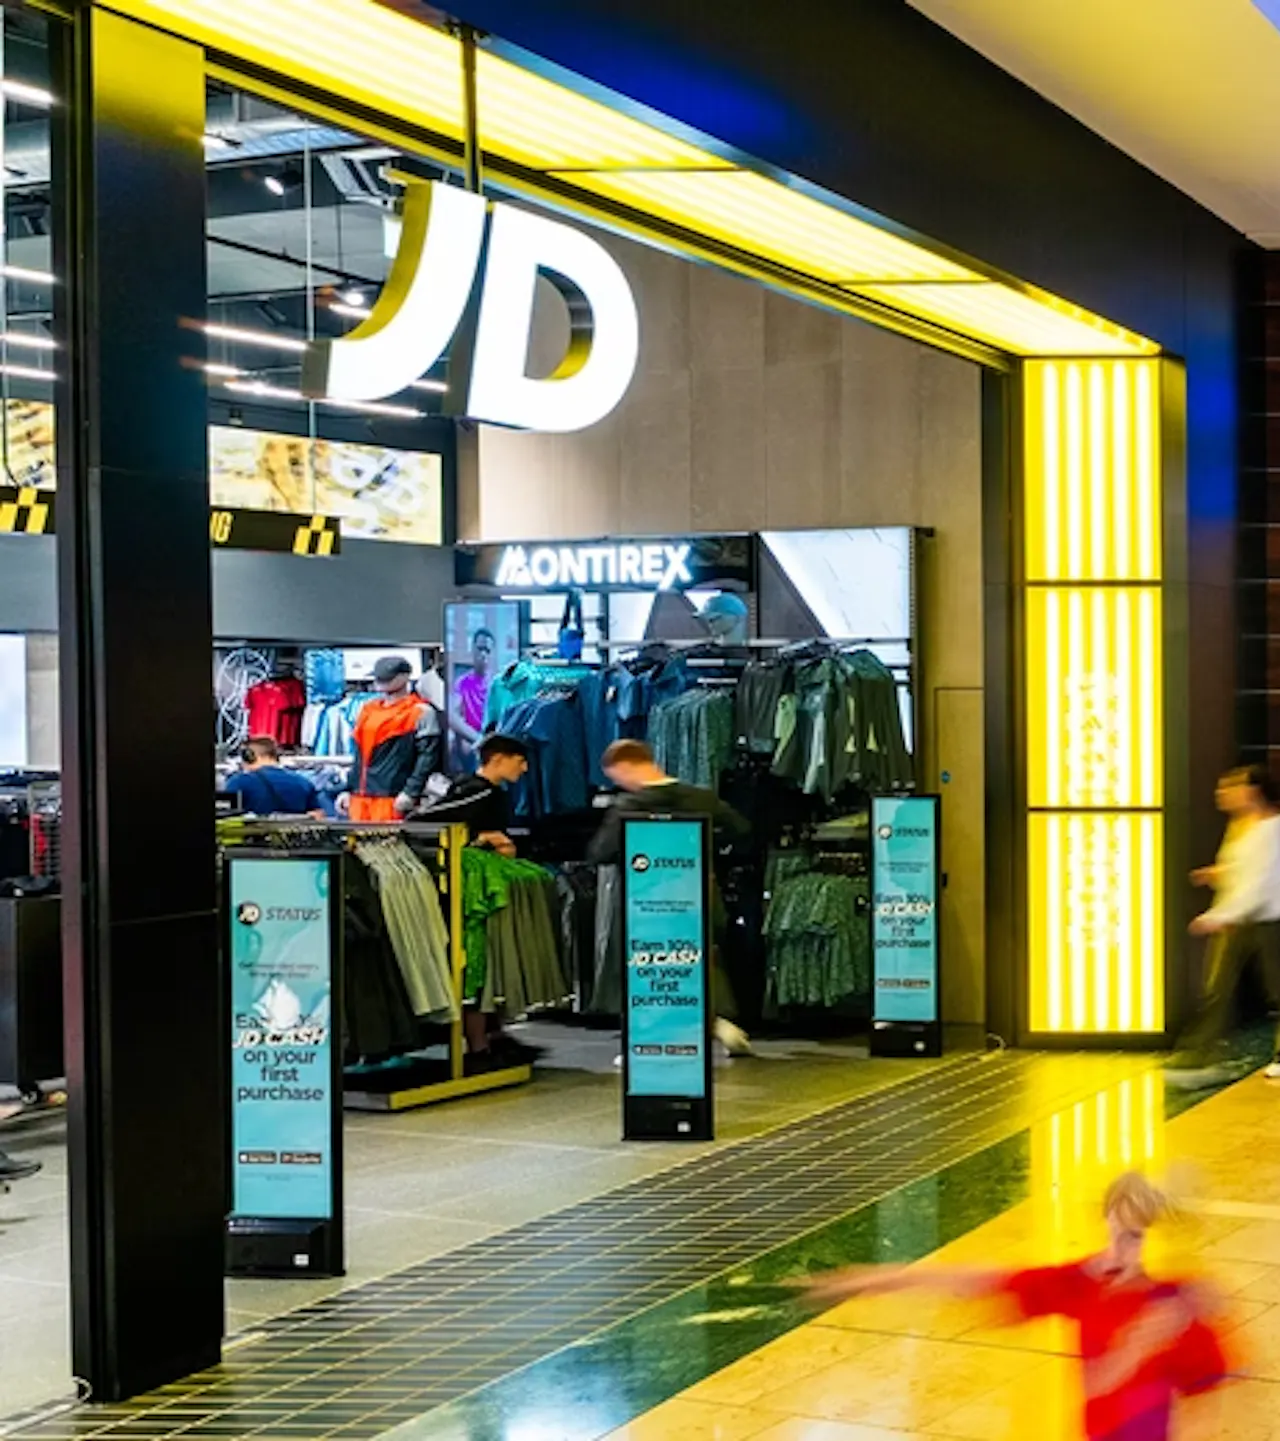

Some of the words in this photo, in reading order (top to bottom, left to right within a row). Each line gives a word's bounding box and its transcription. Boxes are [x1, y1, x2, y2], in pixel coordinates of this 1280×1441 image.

[308, 178, 639, 432] JD
[495, 544, 692, 590] MONTIREX
[266, 908, 323, 921] STATUS
[631, 939, 664, 951] Earn
[637, 967, 656, 977] on
[659, 967, 693, 979] your
[650, 980, 679, 992] first
[631, 994, 698, 1008] purchase
[244, 1050, 268, 1063] on
[274, 1050, 317, 1066] your
[261, 1066, 299, 1082] first
[237, 1084, 324, 1102] purchase
